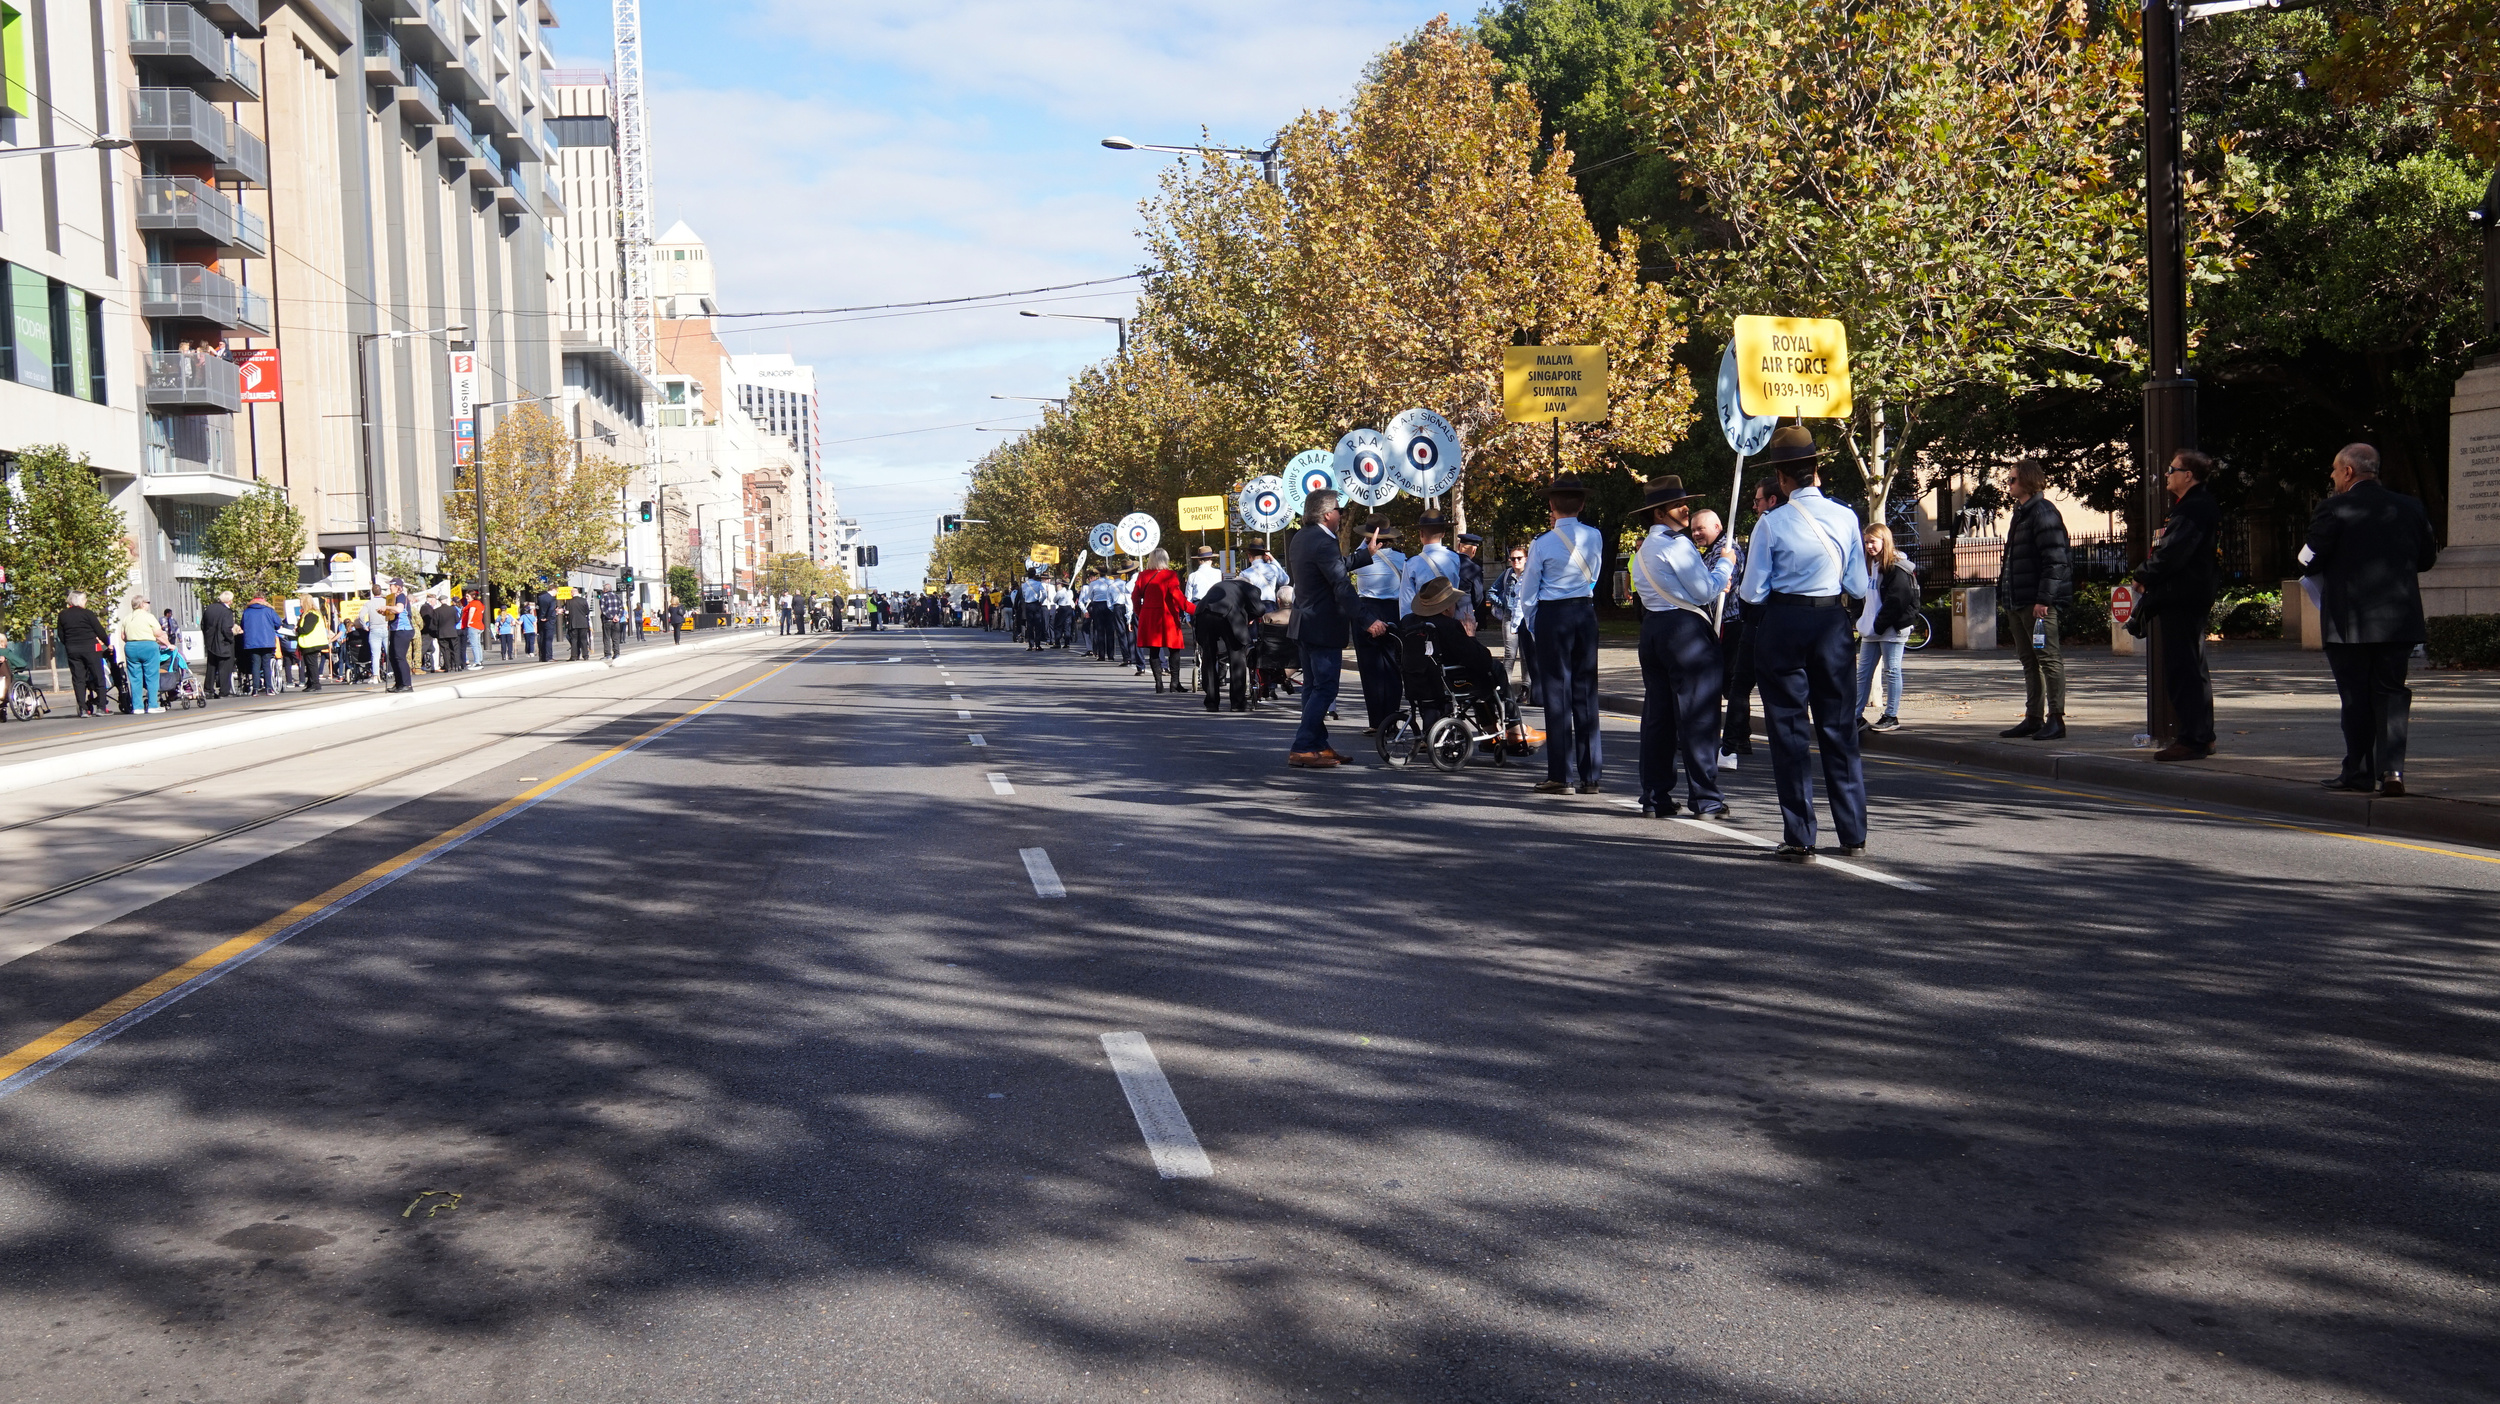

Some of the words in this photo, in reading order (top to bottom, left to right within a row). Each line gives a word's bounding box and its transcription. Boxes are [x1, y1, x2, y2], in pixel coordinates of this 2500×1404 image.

[16, 316, 49, 342] TODAY!
[73, 310, 86, 394] urbanest
[1772, 335, 1812, 353] ROYAL
[1537, 355, 1573, 365] MALAYA
[1761, 356, 1783, 373] AIR
[1787, 357, 1827, 374] FORCE
[1528, 371, 1582, 381] SINGAPORE
[461, 379, 469, 415] Wilson
[1533, 386, 1577, 396] SUMATRA
[1763, 382, 1829, 401] (1939-1945)
[1544, 402, 1566, 412] JAVA
[1421, 412, 1455, 442] SIGNALS
[1721, 403, 1771, 450] MALAYA
[1346, 436, 1382, 451] RAA
[1298, 453, 1327, 467] RAAF
[1246, 479, 1282, 494] RAA
[1289, 472, 1300, 501] AIRFIELD
[1341, 469, 1369, 500] FLYING
[1394, 471, 1422, 493] RADAR
[1429, 465, 1457, 494] SECTION
[1242, 502, 1257, 525] SOUTH
[1260, 521, 1279, 529] WEST
[2117, 592, 2125, 600] NO
[1955, 601, 1963, 613] 21
[2114, 609, 2129, 617] ENTRY
